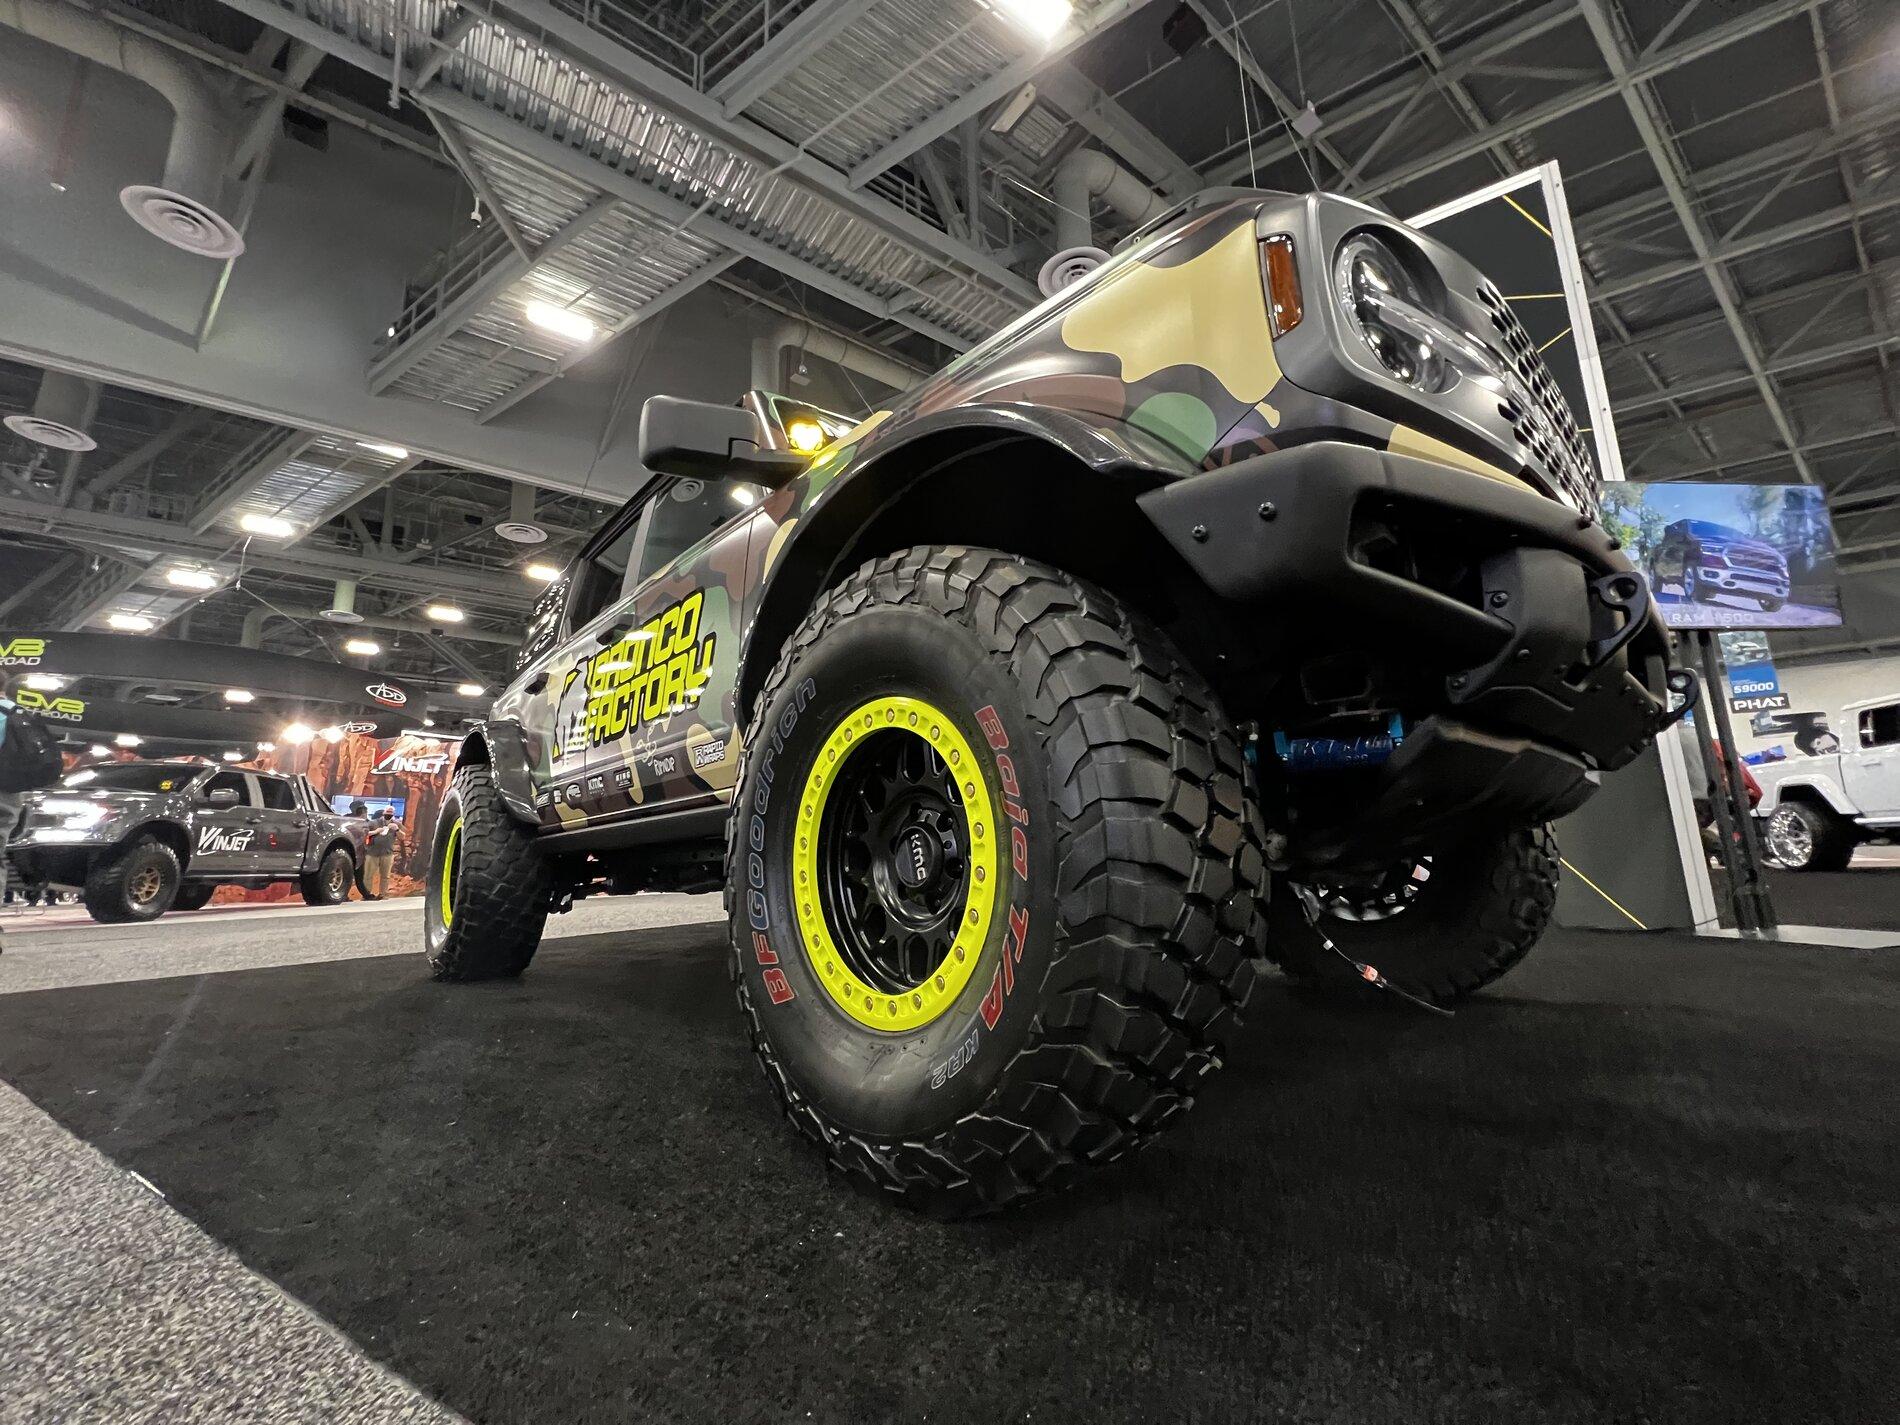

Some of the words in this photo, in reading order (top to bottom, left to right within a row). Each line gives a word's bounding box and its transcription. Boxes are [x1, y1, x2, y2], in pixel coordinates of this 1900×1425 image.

[589, 591, 704, 697] BRONCO
[16, 689, 85, 715] DV8
[585, 638, 714, 744] FACTORY
[1733, 696, 1785, 711] PHAT
